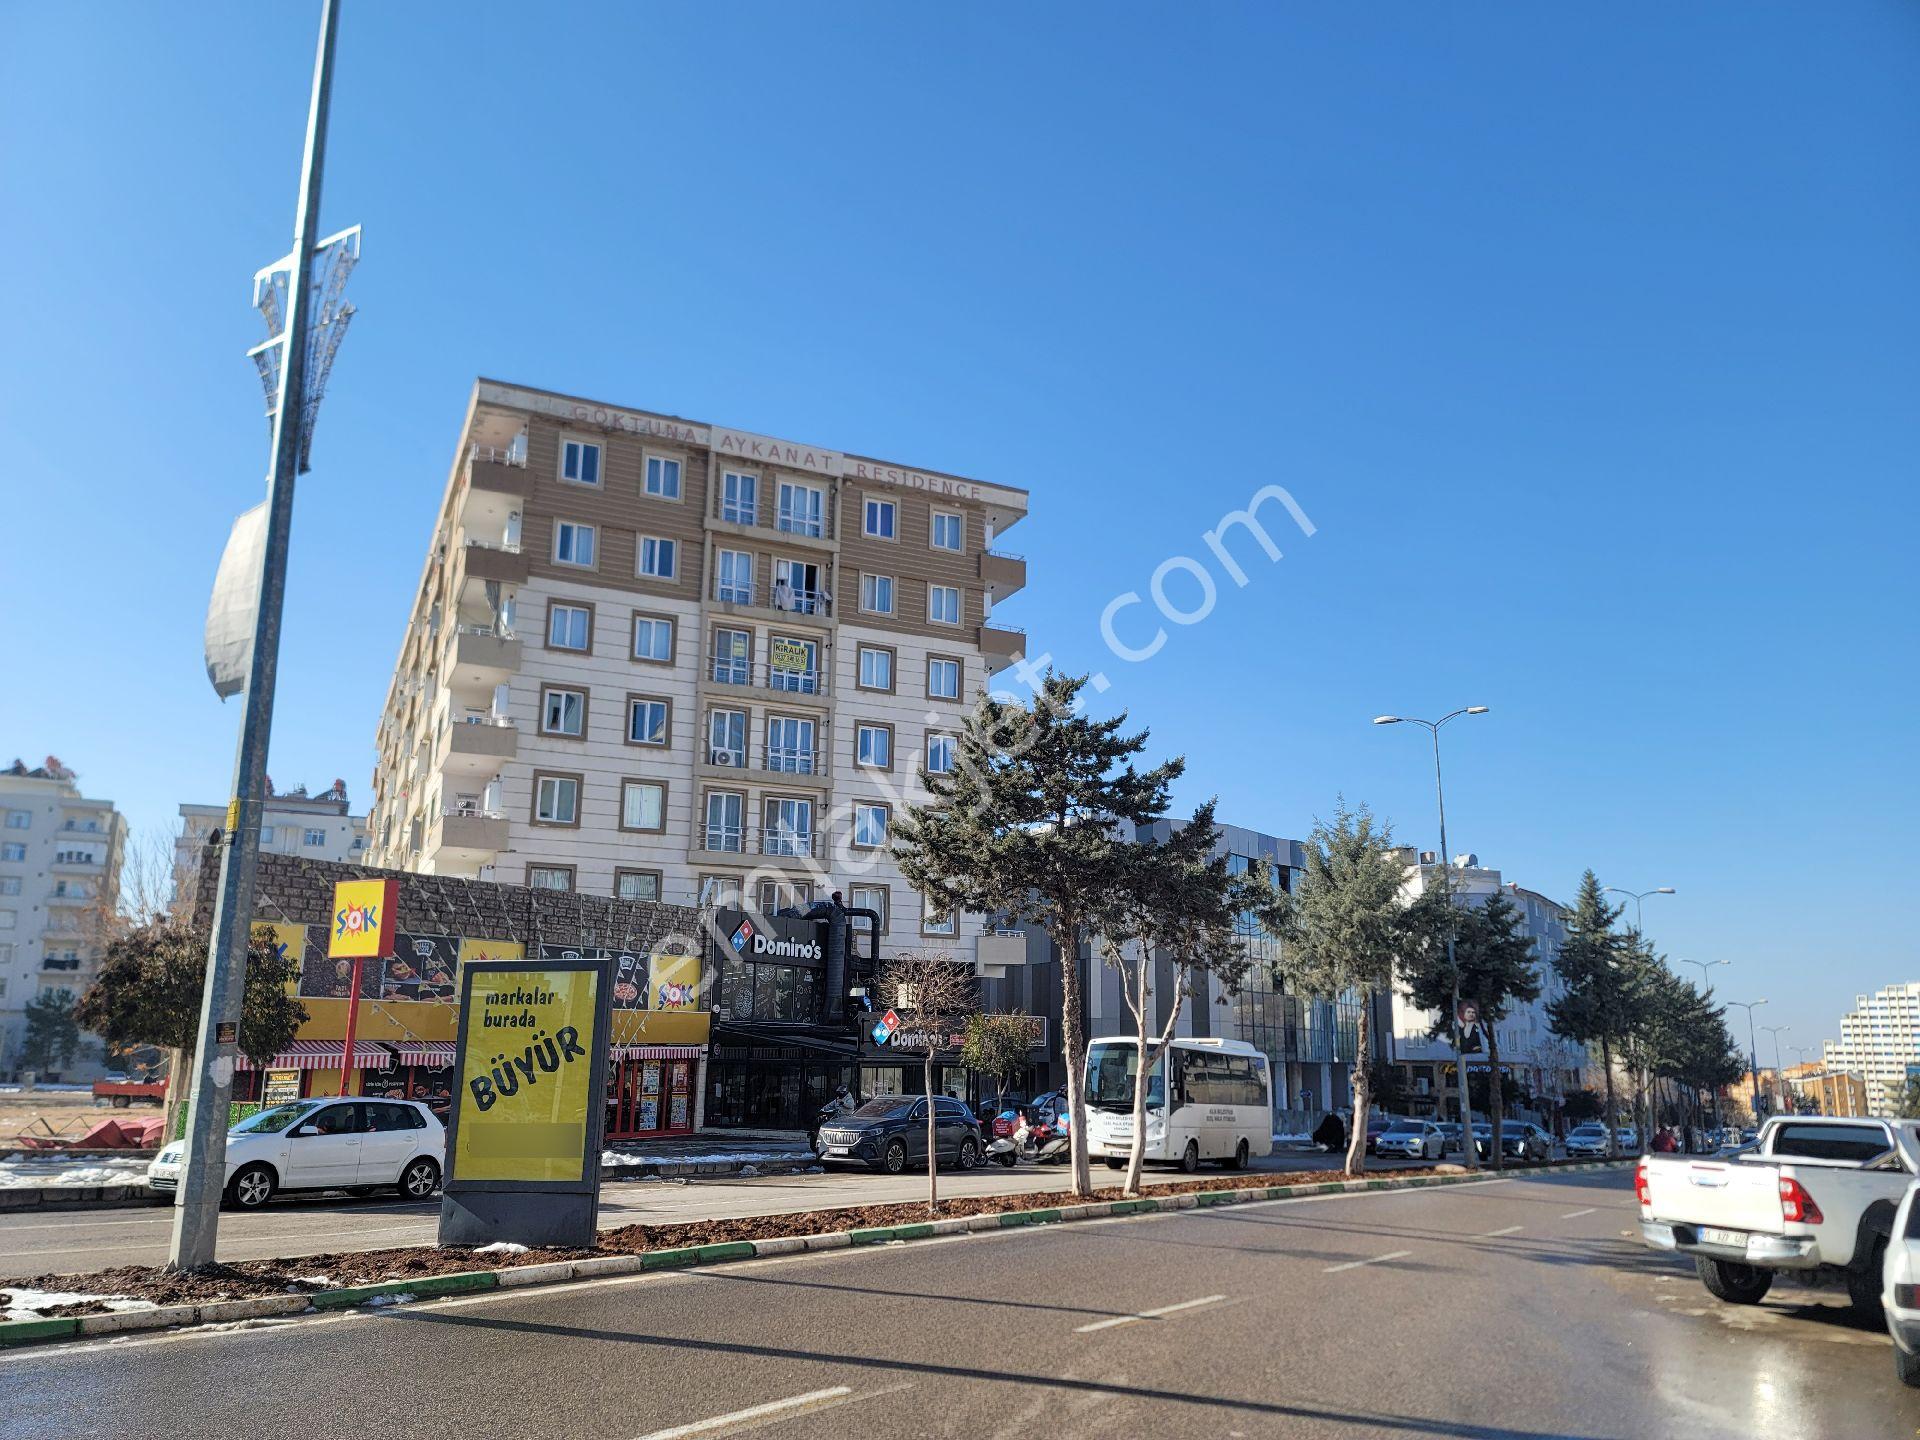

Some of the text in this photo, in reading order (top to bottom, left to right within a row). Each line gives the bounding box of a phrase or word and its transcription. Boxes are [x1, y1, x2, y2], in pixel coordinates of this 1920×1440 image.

[720, 434, 832, 470] AYKANAT
[336, 905, 378, 940] ŞOK
[753, 934, 822, 960] Domino's
[485, 986, 554, 1005] markalar
[484, 1009, 536, 1027] burada
[470, 1026, 585, 1111] BÜYÜR
